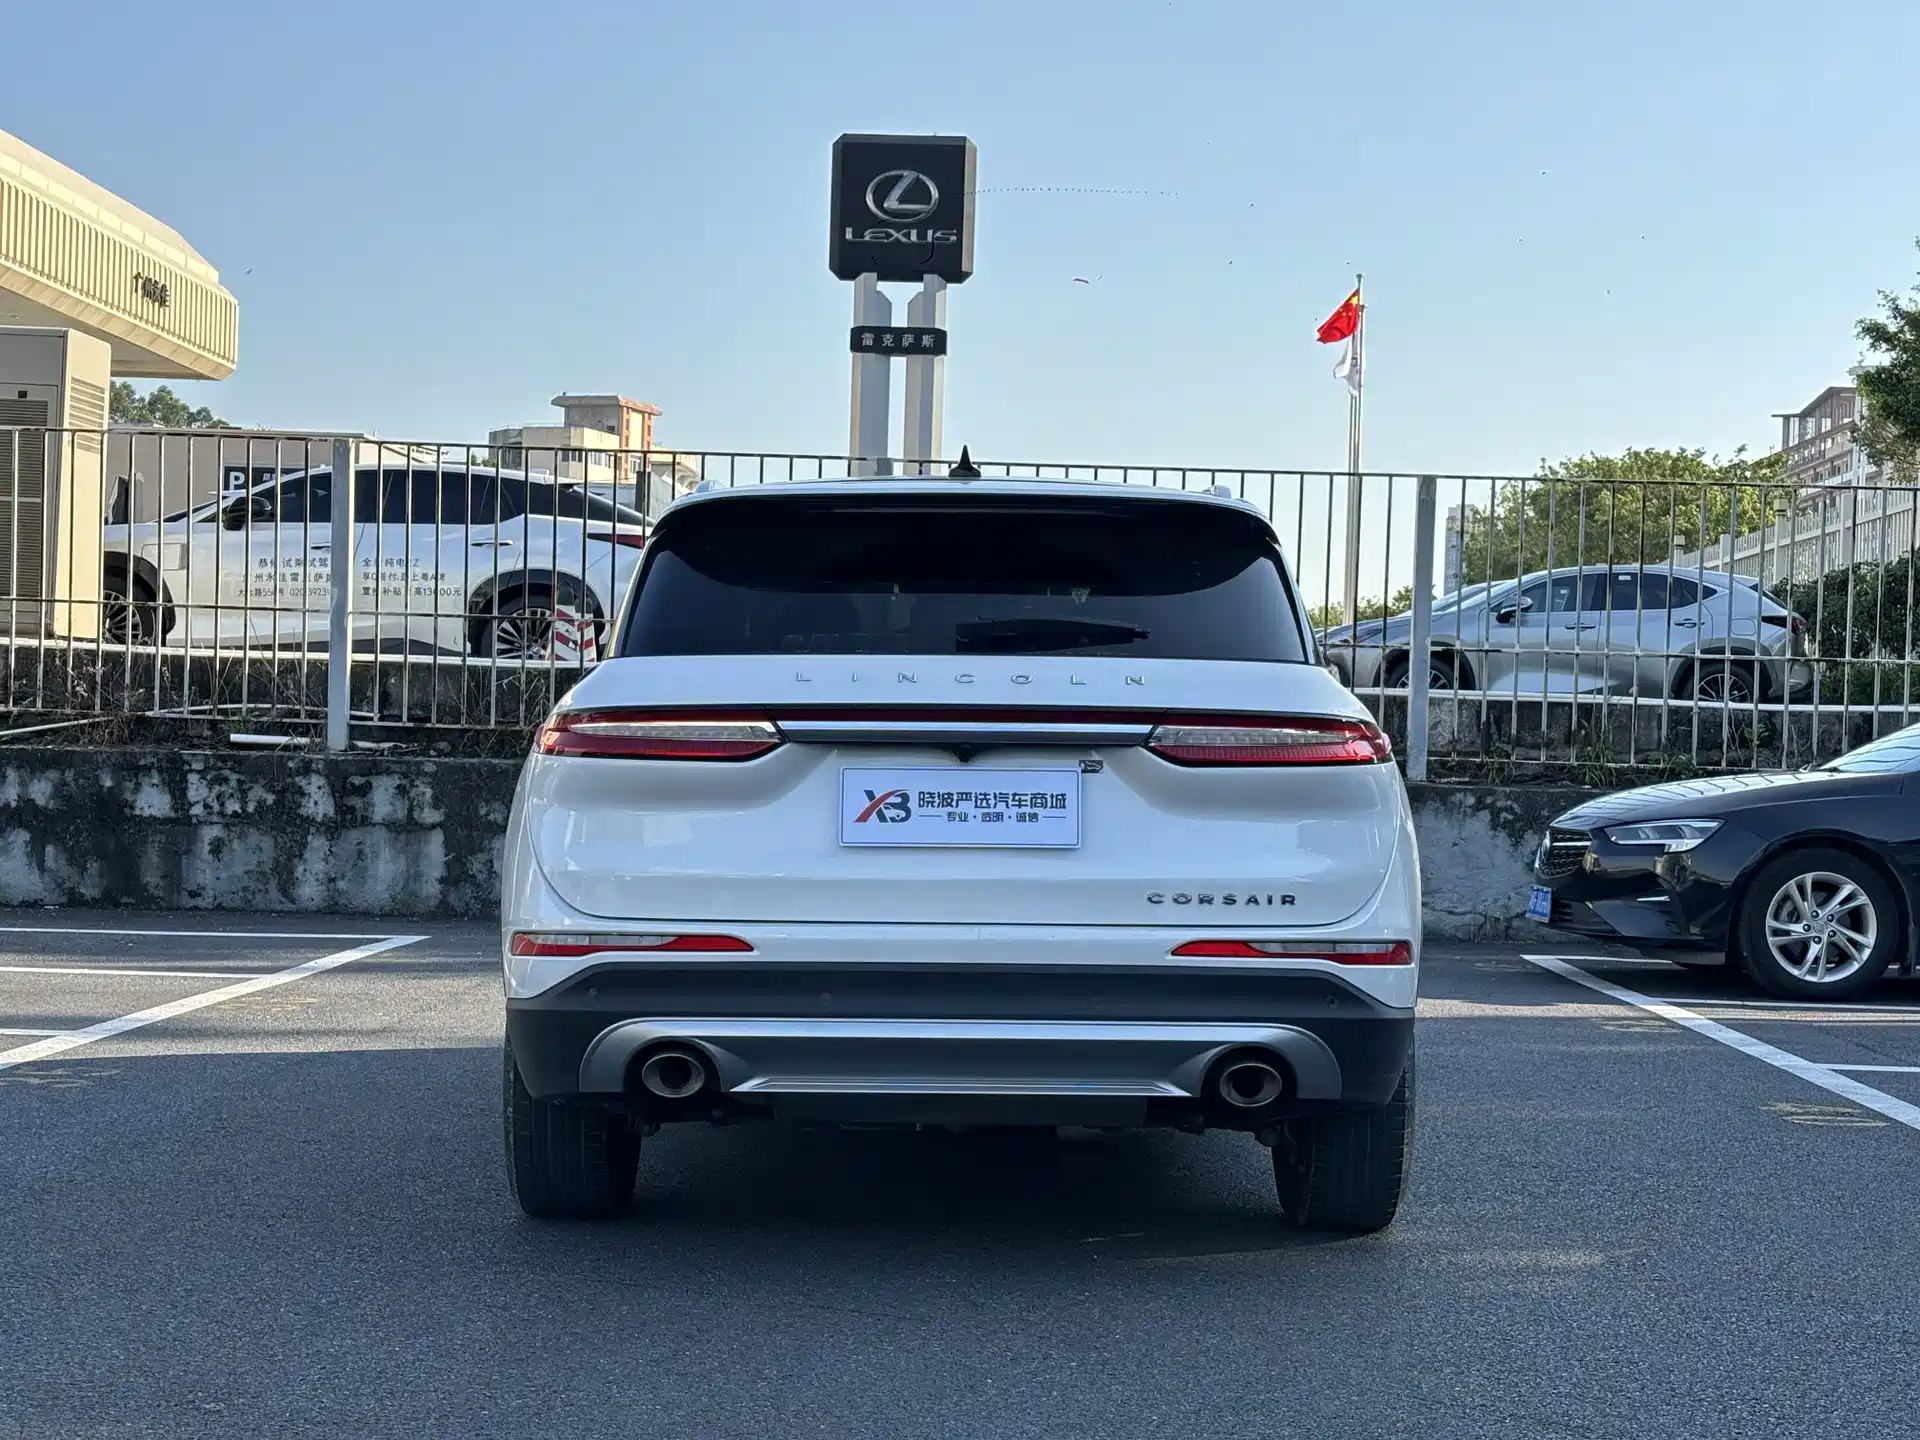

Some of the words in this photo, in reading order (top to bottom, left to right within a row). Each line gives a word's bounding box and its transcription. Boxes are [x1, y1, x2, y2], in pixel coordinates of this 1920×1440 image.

[845, 226, 957, 243] LEXUS
[861, 333, 936, 348] 雷克萨斯
[361, 557, 420, 568] 全纯电Z
[795, 672, 1146, 686] LINCOLN
[918, 791, 1067, 810] 晓波严选汽车商城
[1146, 892, 1296, 906] CORSAIR
